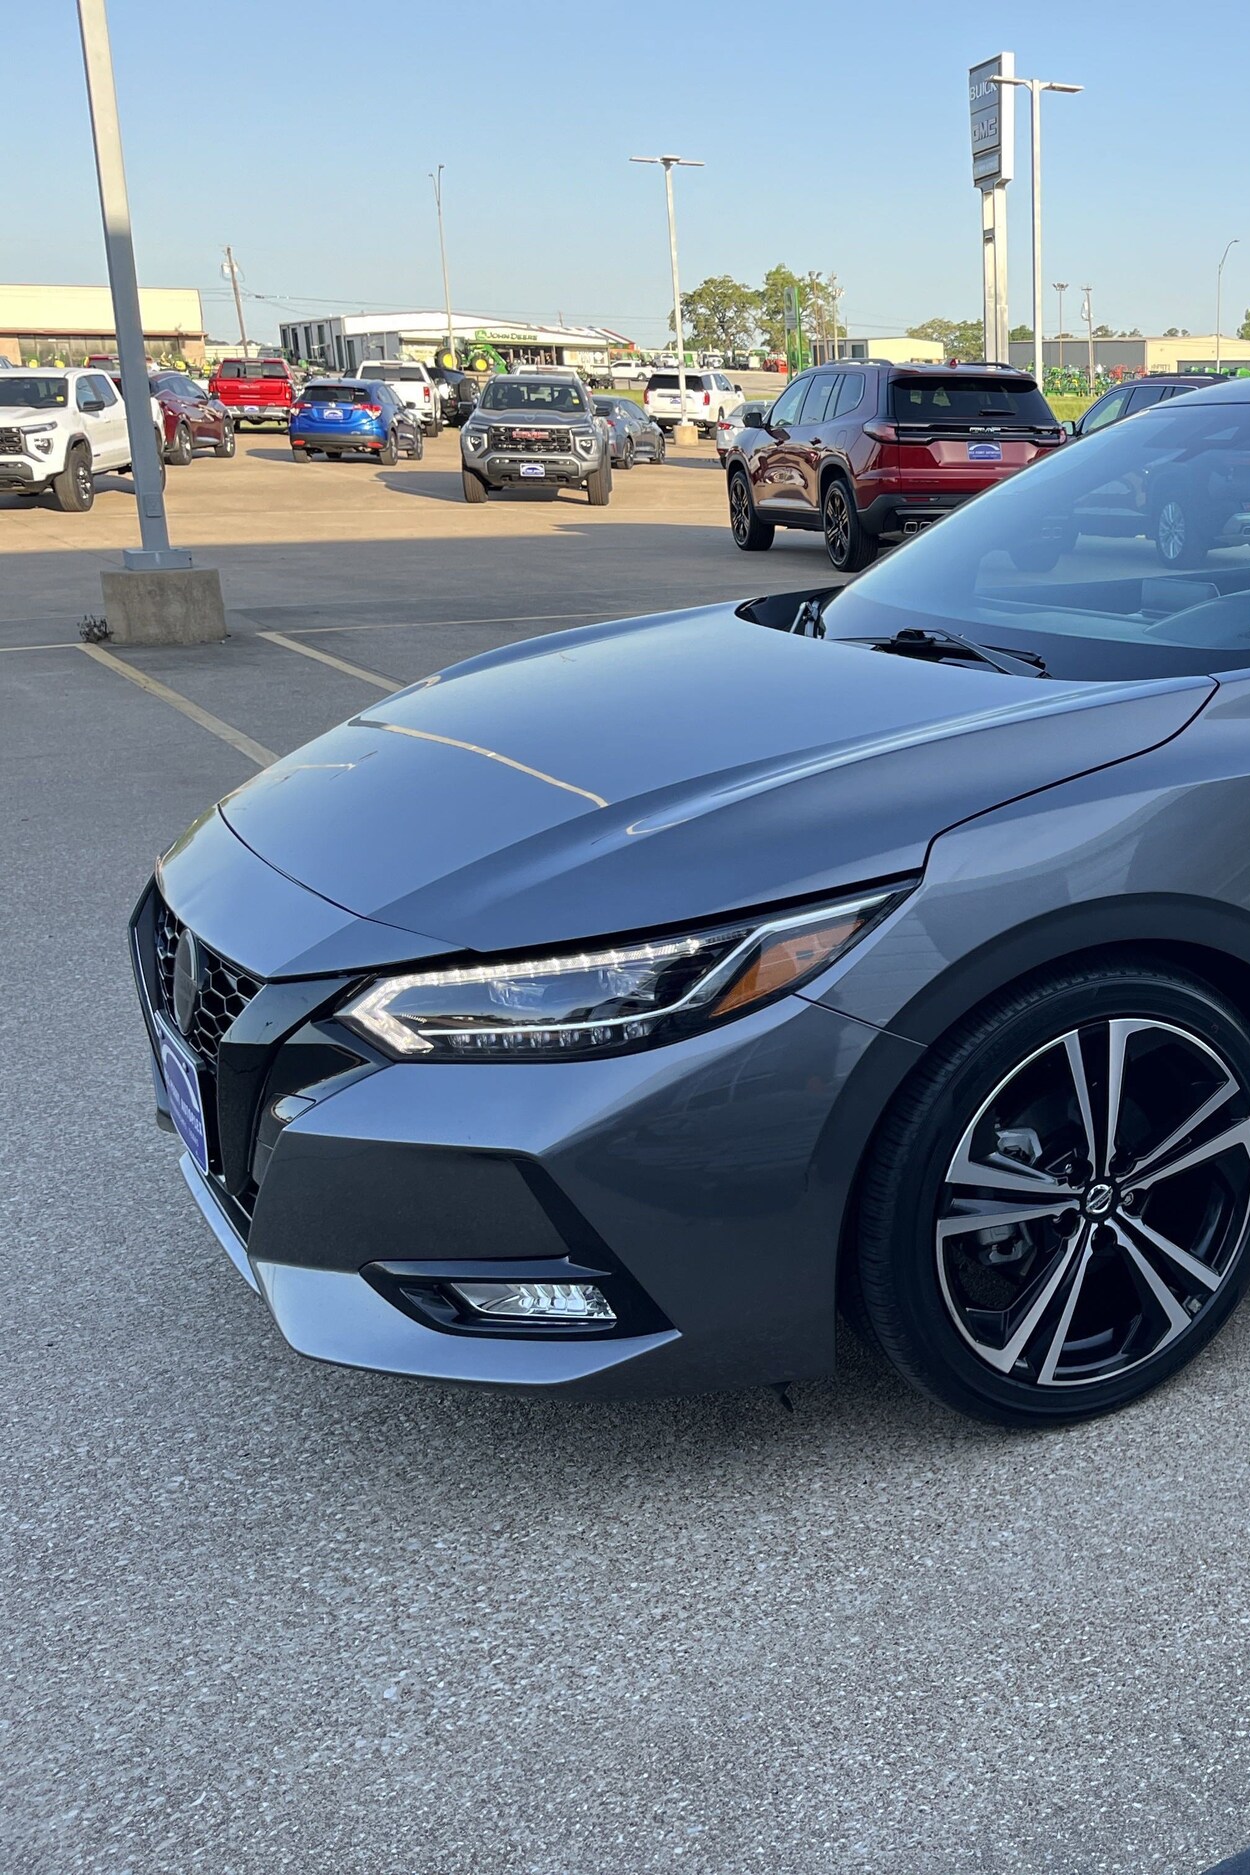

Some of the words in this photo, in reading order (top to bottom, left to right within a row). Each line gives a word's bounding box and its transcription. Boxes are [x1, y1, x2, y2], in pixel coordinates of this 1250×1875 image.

[969, 79, 998, 101] BUICK
[972, 117, 998, 143] GMC
[487, 331, 510, 339] JOHN
